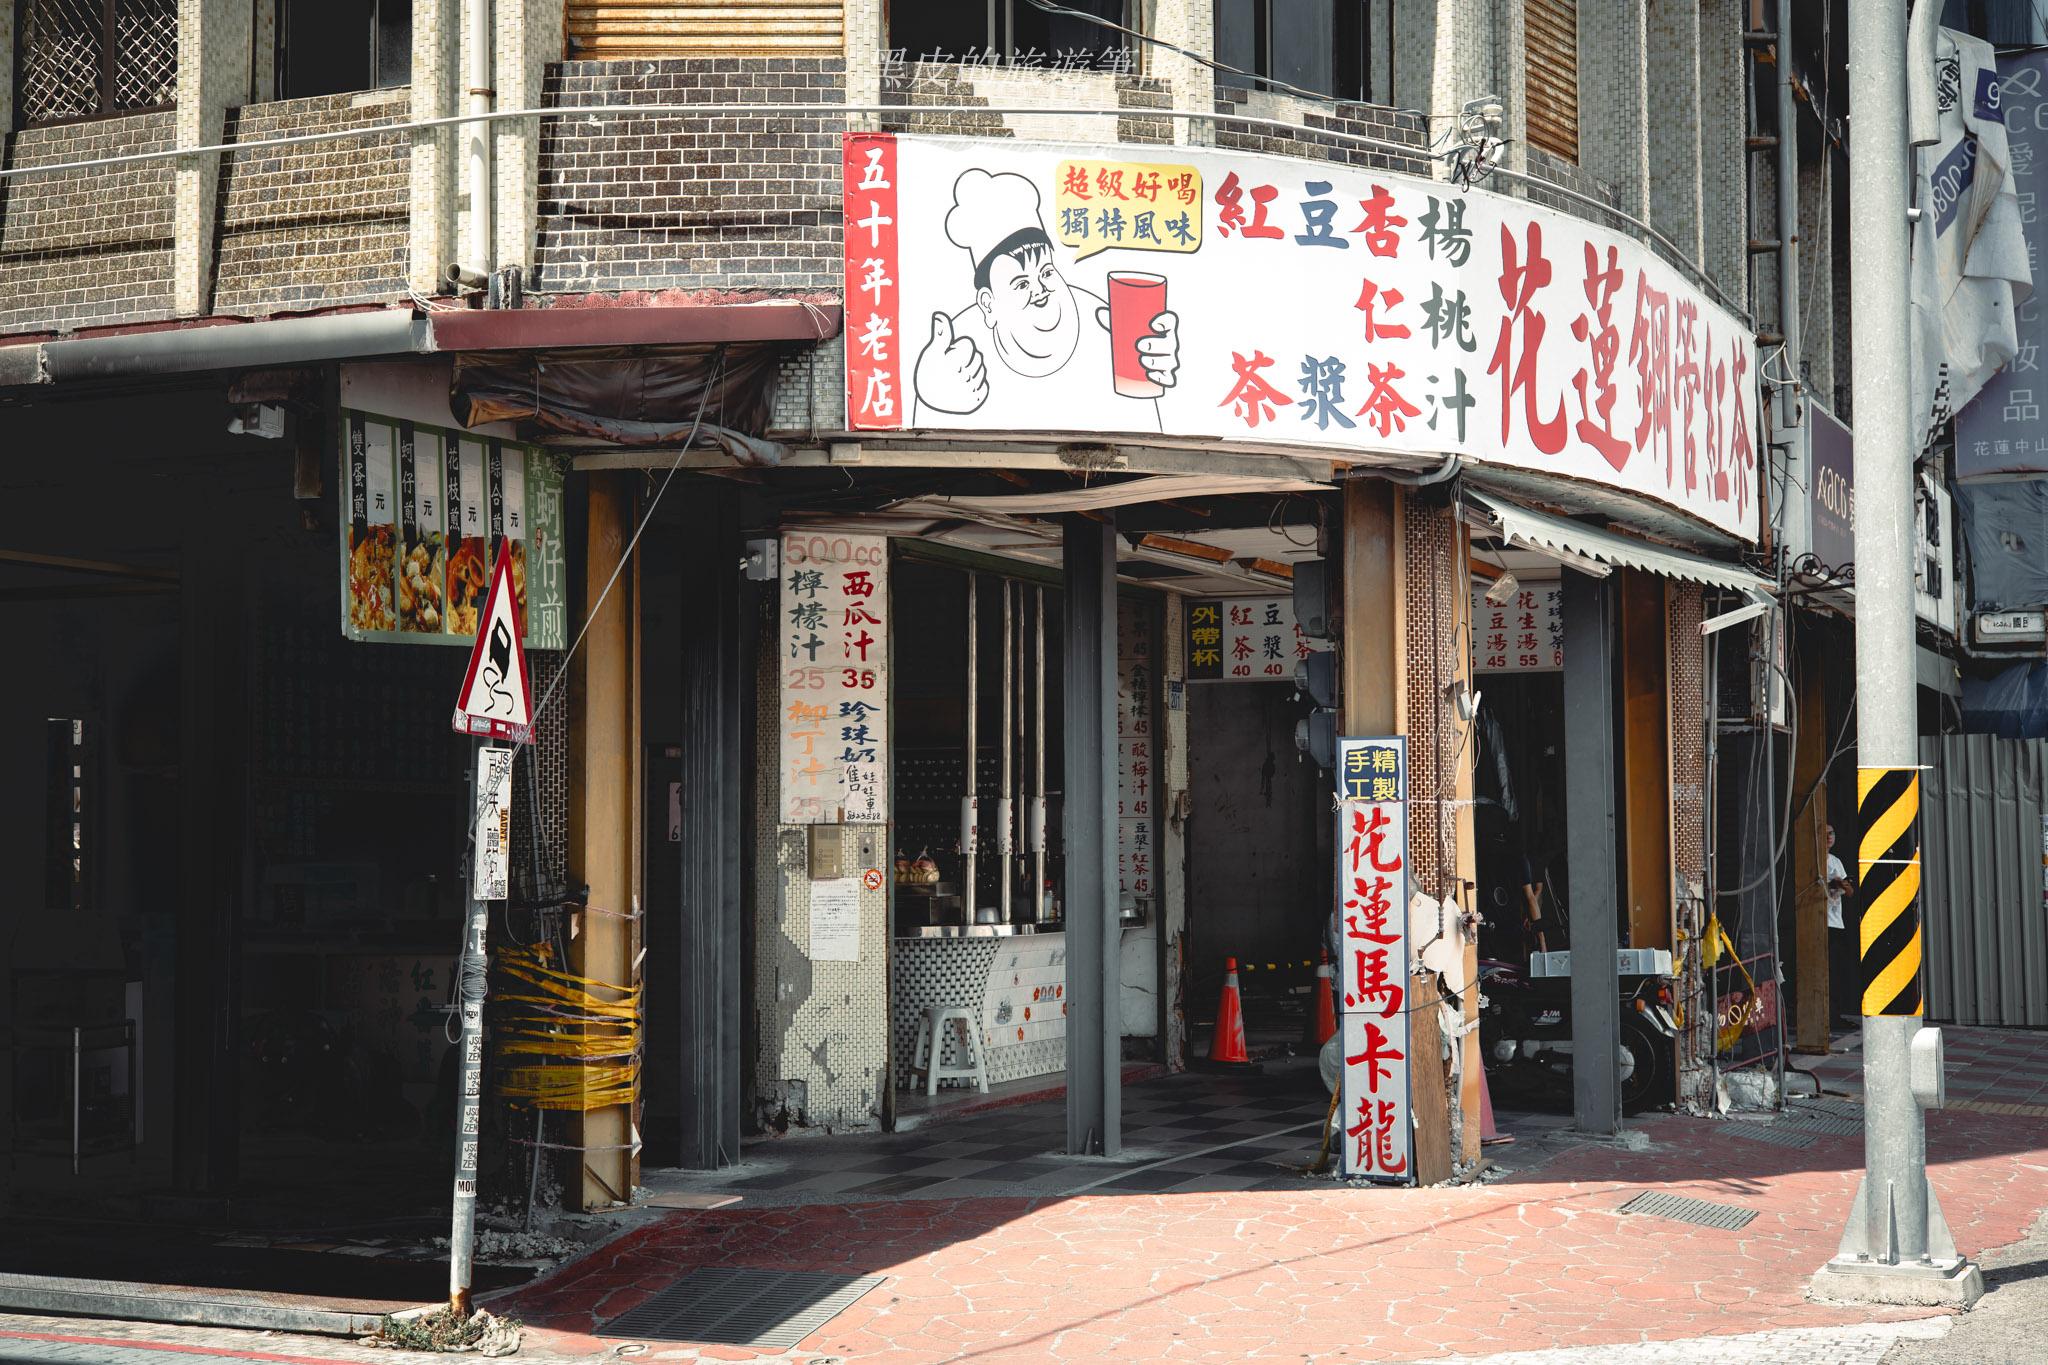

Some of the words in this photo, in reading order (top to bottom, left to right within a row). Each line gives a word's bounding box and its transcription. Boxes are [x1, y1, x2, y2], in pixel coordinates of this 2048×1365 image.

[1062, 165, 1196, 205] 超級好喝
[1060, 207, 1197, 247] 獨特風味
[858, 147, 893, 417] 五十年老店
[1349, 184, 1421, 438] 杏仁茶
[1418, 195, 1477, 444] 楊桃汁
[1487, 220, 1754, 524] 花蓮鋼管紅茶
[352, 429, 366, 520] 雙蛋煎
[401, 440, 415, 526] 蚵仔煎
[448, 447, 461, 532] 花枝煎
[490, 456, 503, 536] 綜合煎
[375, 494, 385, 510] 元
[423, 500, 432, 517] 元
[468, 506, 477, 523] 元
[510, 512, 519, 528] 元
[535, 481, 565, 648] 蚵仔煎
[785, 536, 882, 566] 500cc
[787, 570, 829, 661] 檸檬汁
[842, 571, 881, 662] 西瓜汁
[1230, 605, 1255, 661] 紅茶
[1263, 603, 1284, 660] 豆漿
[1517, 591, 1538, 650] 花生湯
[1192, 606, 1220, 672] 外帶杯
[1488, 656, 1506, 667] 45
[1520, 655, 1538, 666] 55
[1554, 651, 1564, 666] 6
[788, 669, 825, 690] 25
[841, 668, 875, 690] 35
[1232, 665, 1250, 676] 40
[1264, 664, 1282, 675] 40
[787, 700, 828, 785] 柳丁汁
[1134, 721, 1147, 734] 45
[1132, 743, 1149, 796] 酸梅汁
[790, 796, 821, 817] 25
[1134, 801, 1147, 814] 45
[1134, 880, 1147, 892] 45
[1344, 807, 1405, 1174] 花蓮馬卡龍
